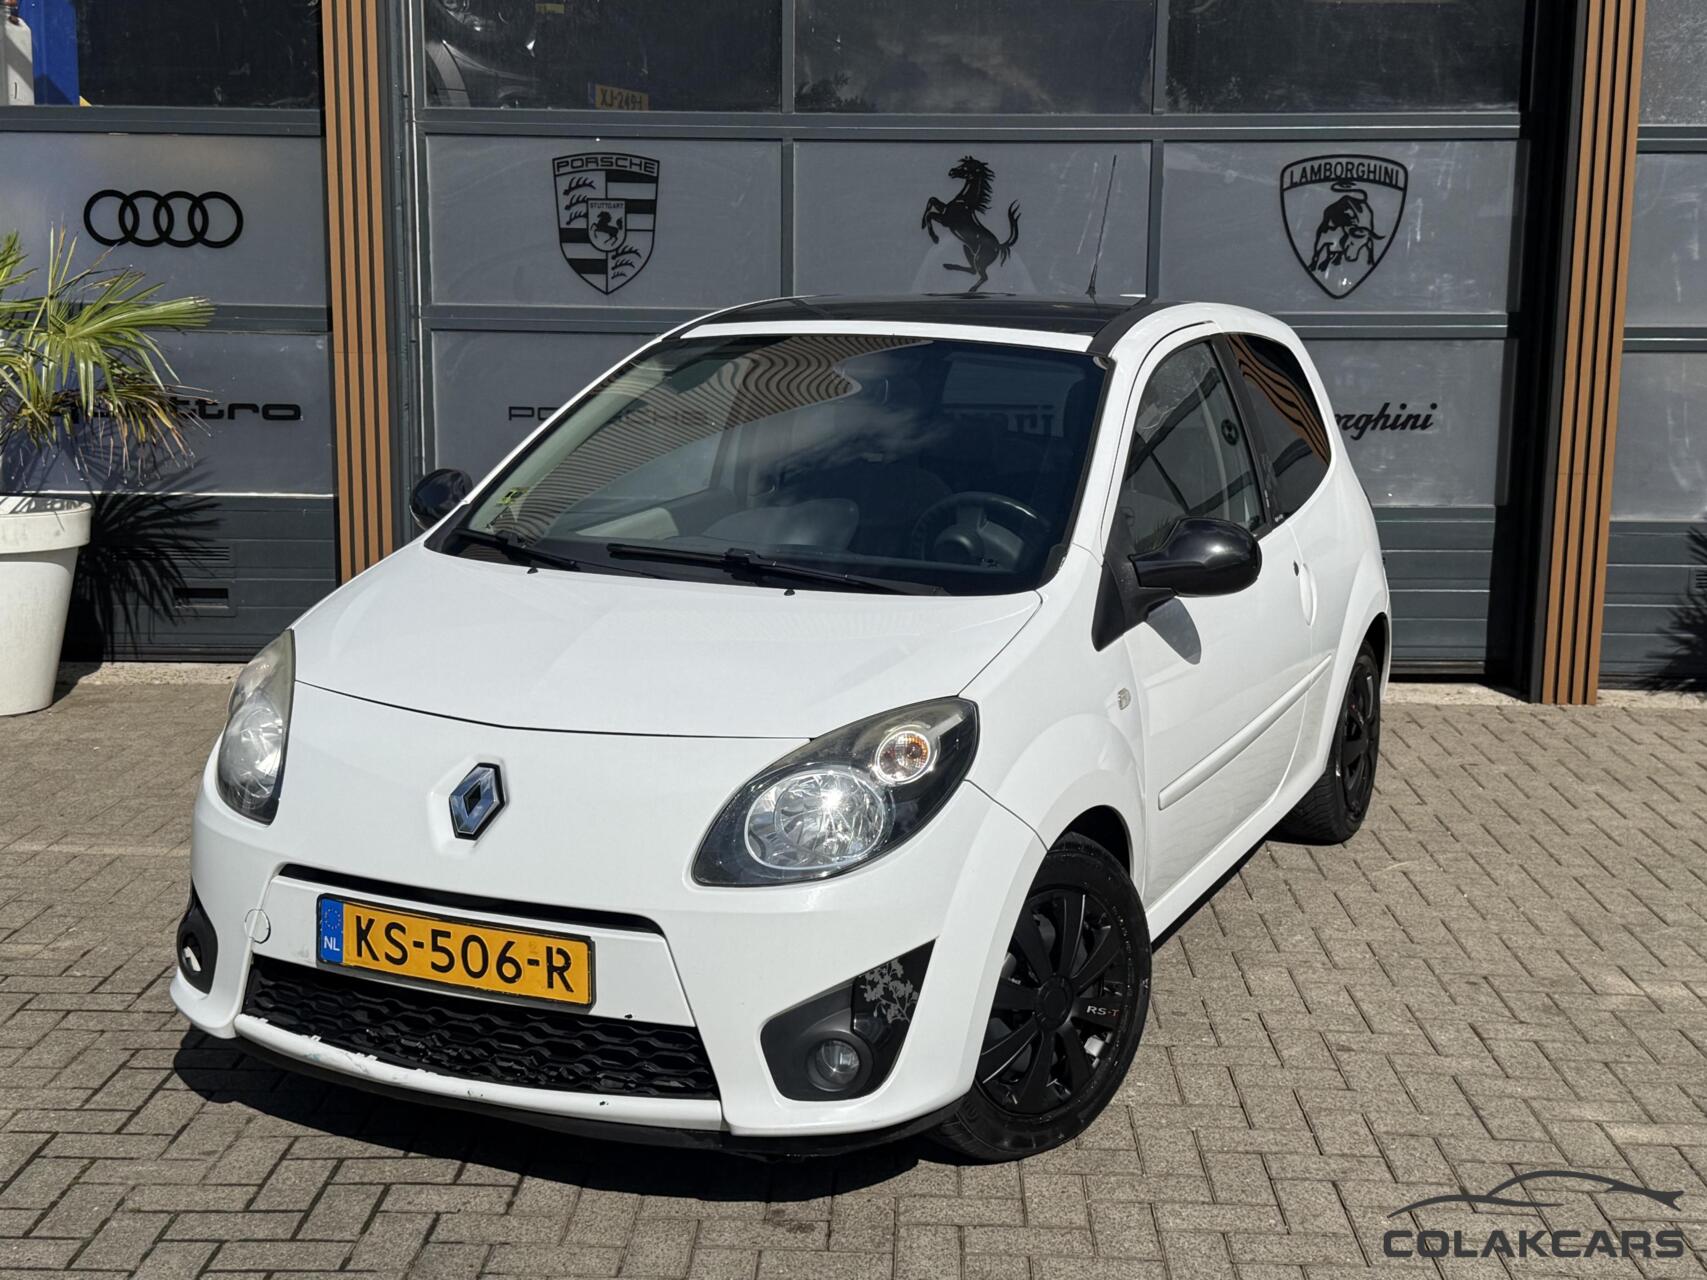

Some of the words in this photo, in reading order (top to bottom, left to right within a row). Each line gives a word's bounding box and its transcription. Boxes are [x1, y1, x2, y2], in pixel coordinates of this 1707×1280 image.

[556, 156, 657, 174] PORSCHE
[1290, 161, 1399, 187] LAMBORGHINI
[323, 935, 341, 951] NL
[355, 915, 574, 993] KS-506-R
